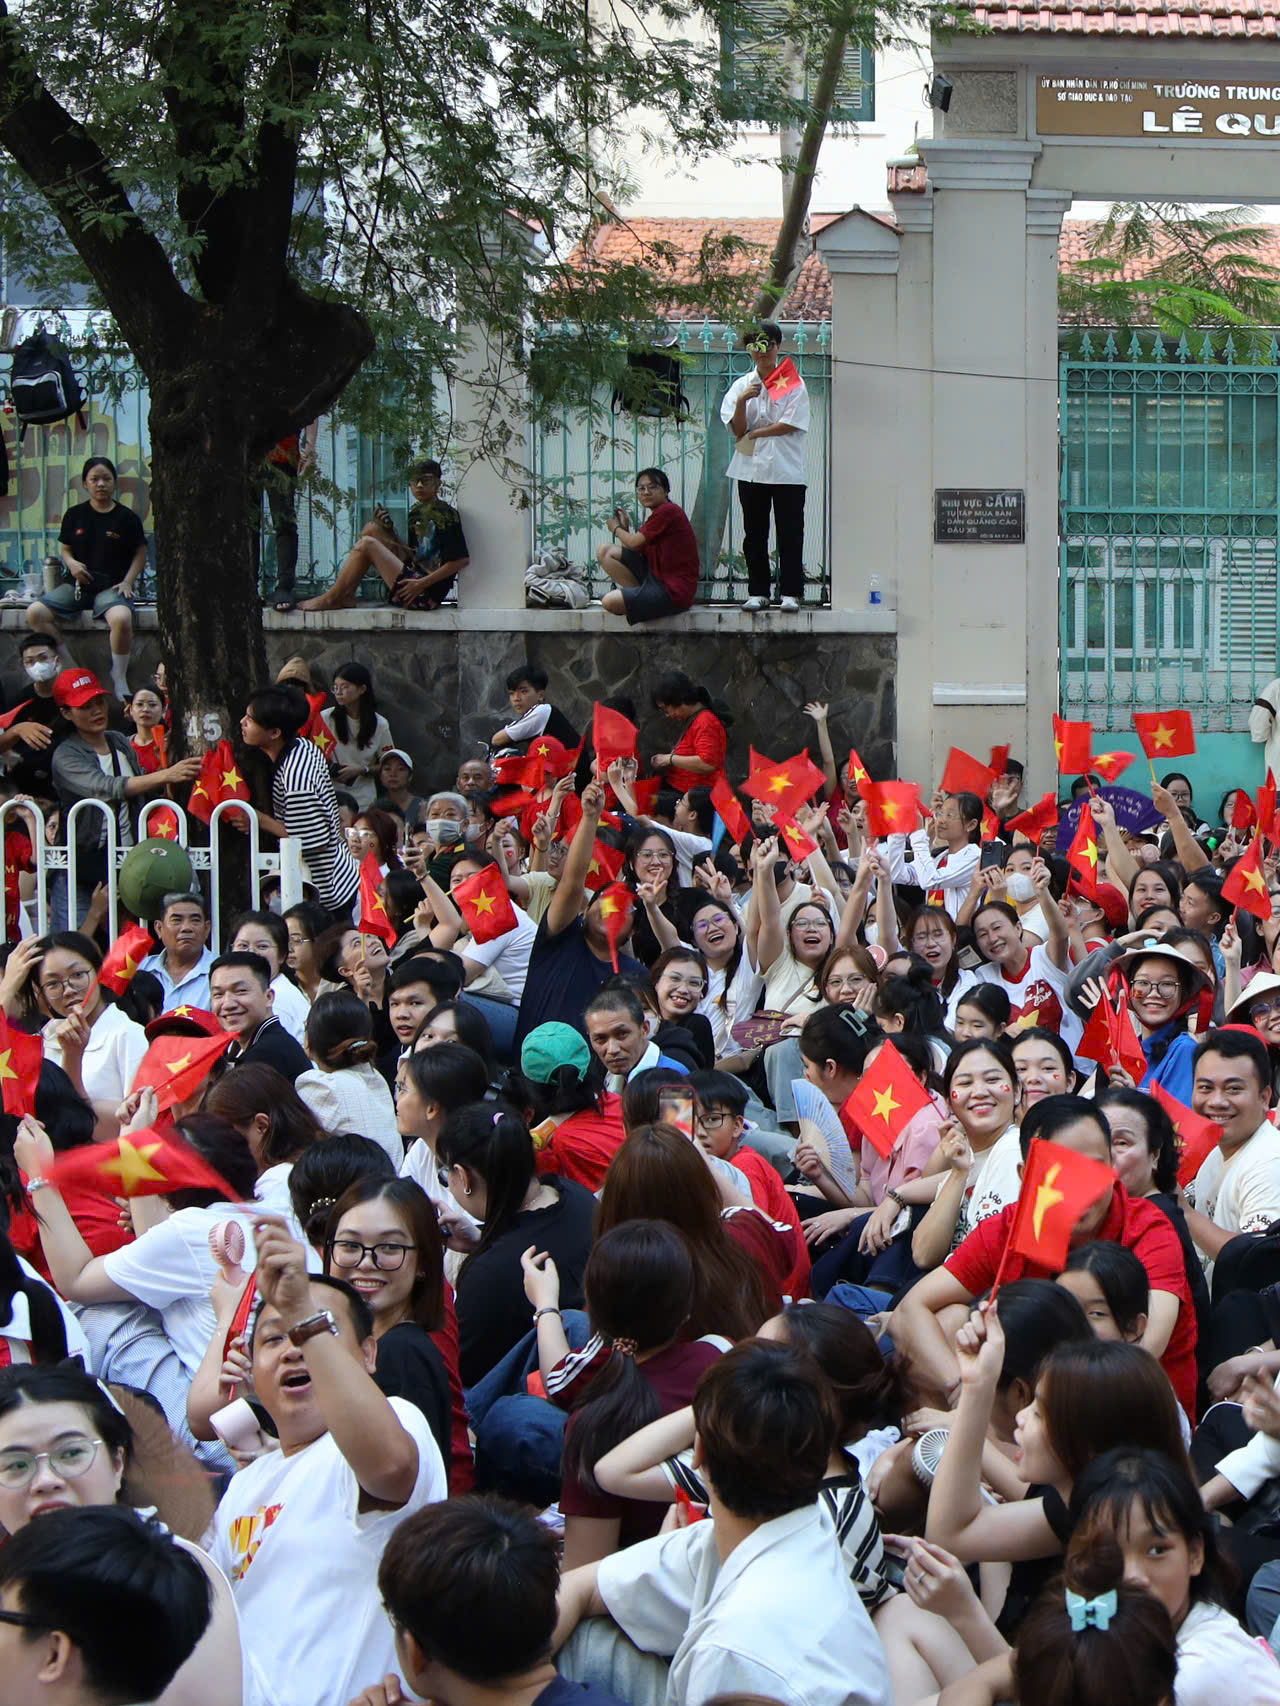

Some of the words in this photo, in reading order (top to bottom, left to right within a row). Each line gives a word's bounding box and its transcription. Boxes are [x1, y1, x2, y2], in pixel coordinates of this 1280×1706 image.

[1052, 80, 1065, 88] BAN
[1131, 81, 1148, 89] MINH
[1153, 80, 1220, 99] TRƯỜNG
[1098, 93, 1104, 102] &
[1143, 105, 1203, 133] LÊ
[941, 499, 960, 507] KHU
[963, 498, 982, 509] VỰC
[985, 493, 1017, 508] CẤM
[186, 711, 222, 741] 45
